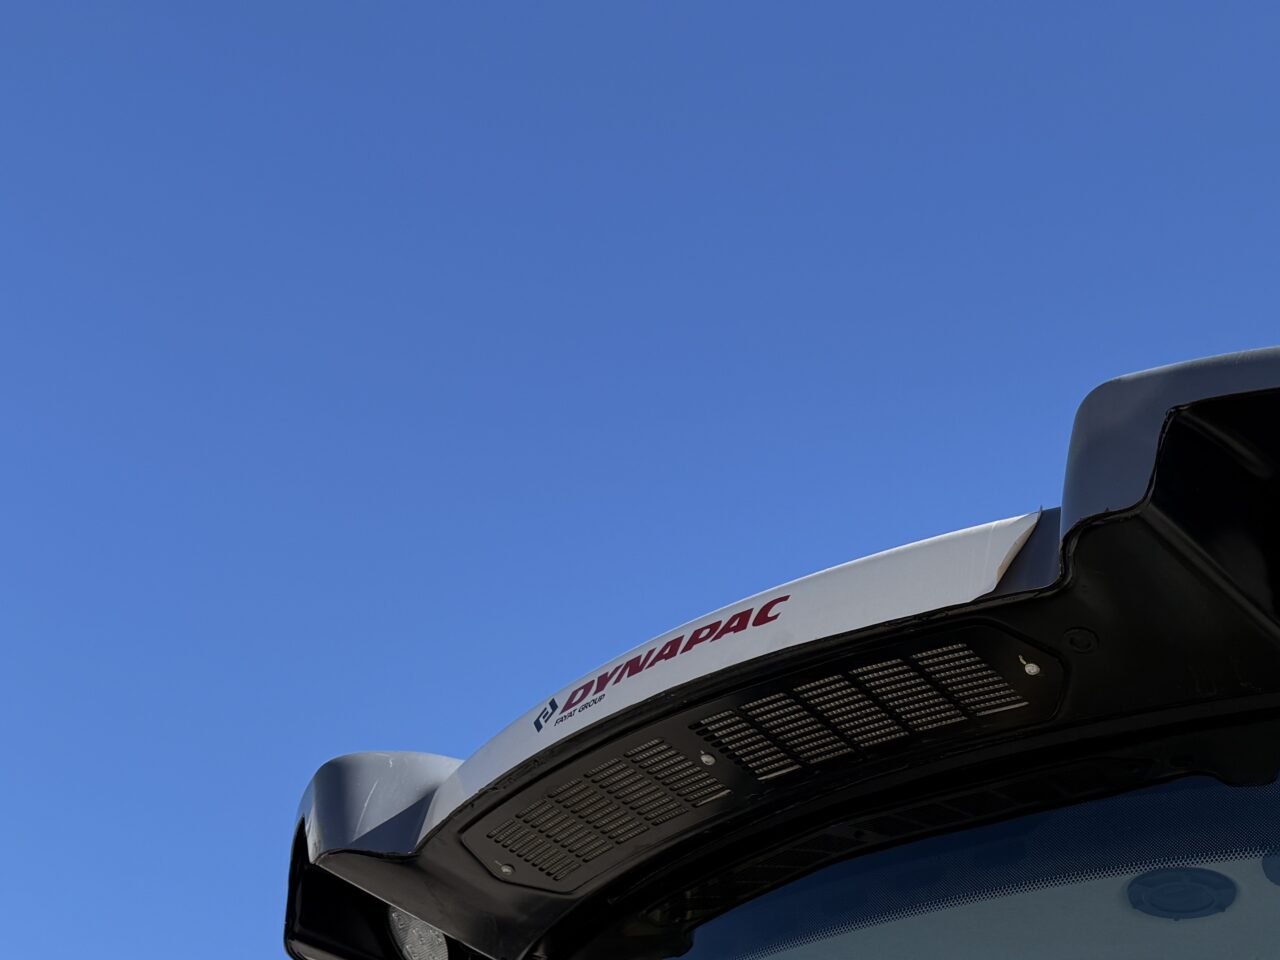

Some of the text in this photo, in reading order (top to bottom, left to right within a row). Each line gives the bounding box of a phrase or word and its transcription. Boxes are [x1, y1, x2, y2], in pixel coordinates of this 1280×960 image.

[559, 594, 791, 715] DYNAPAC
[553, 693, 606, 727] FAYAT GROUP
